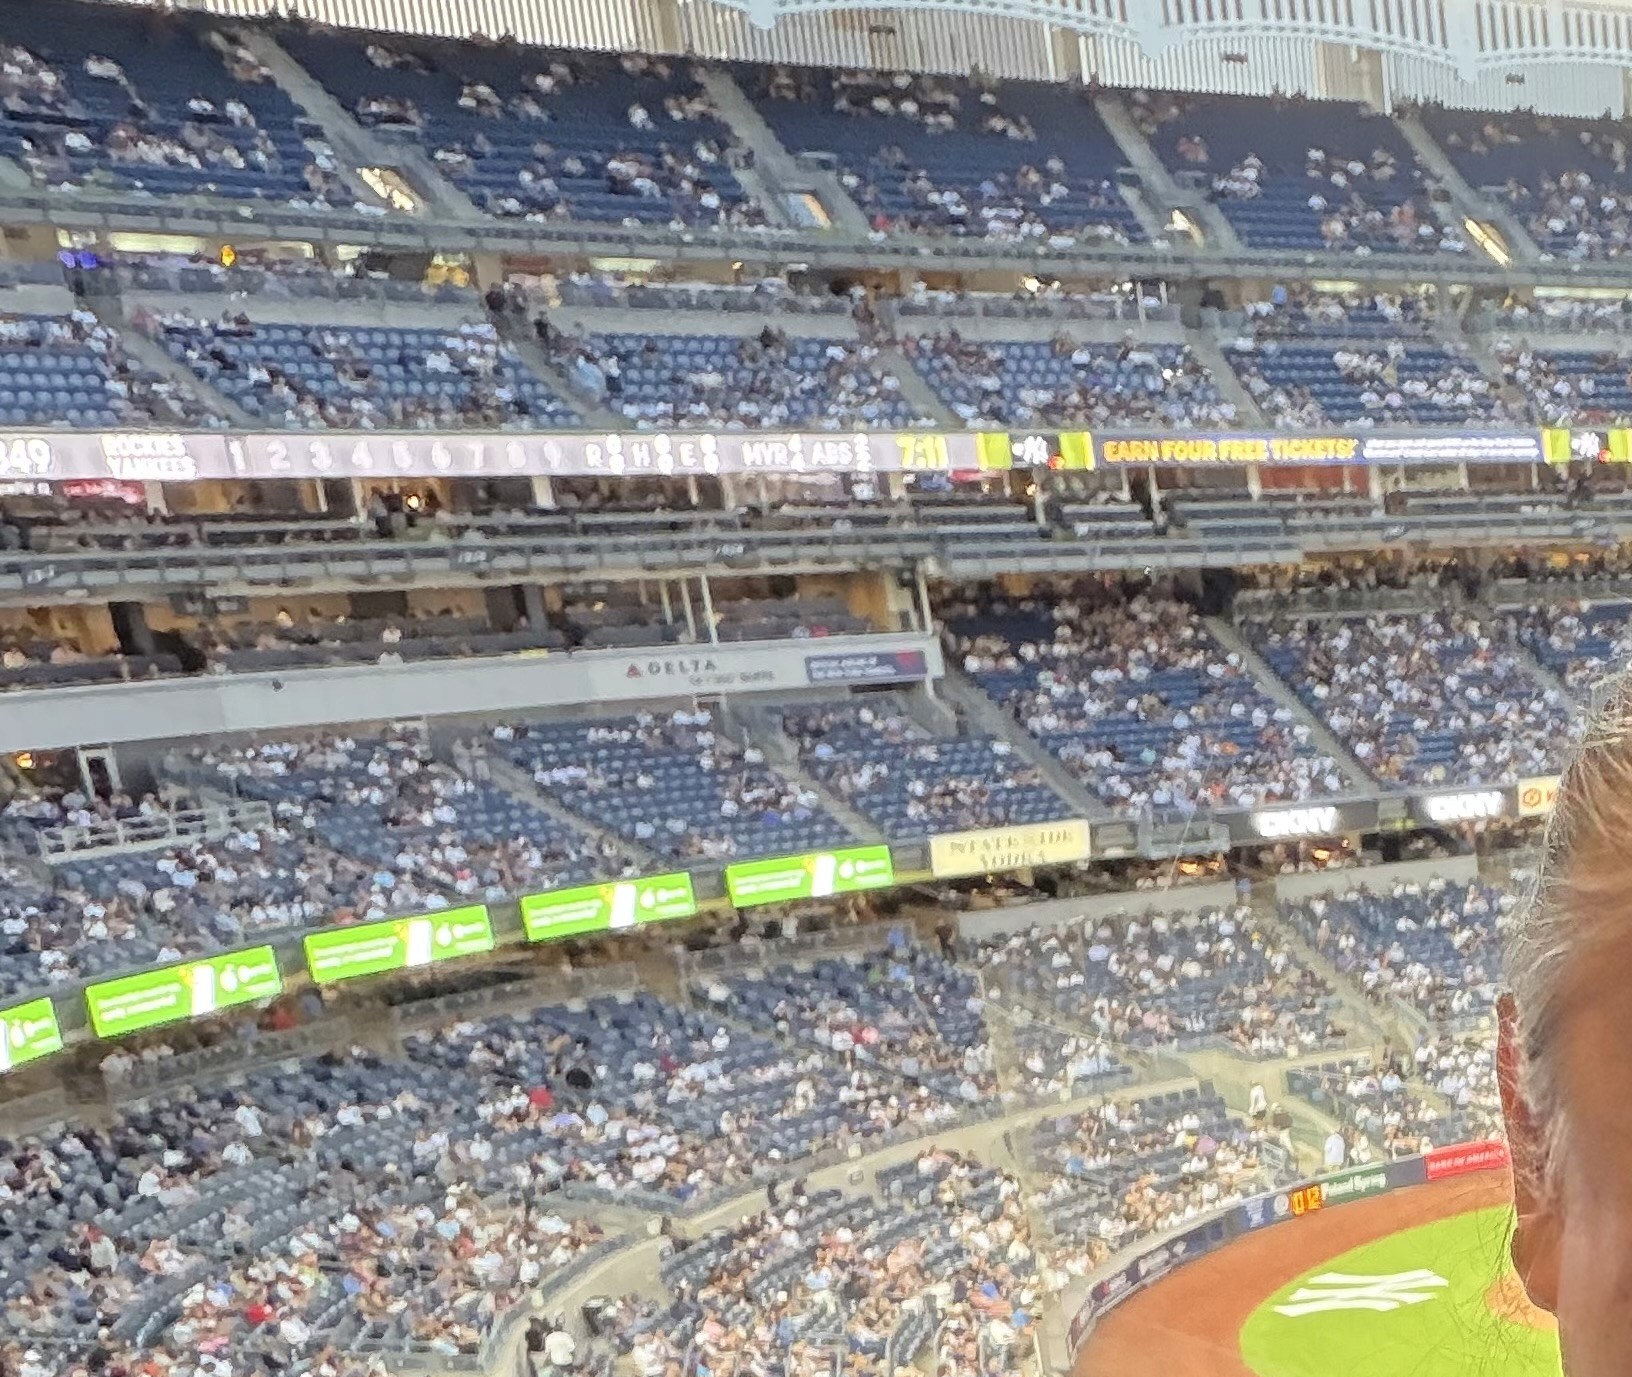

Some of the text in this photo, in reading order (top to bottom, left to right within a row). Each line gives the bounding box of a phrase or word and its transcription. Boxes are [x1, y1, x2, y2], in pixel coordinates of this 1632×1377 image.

[266, 439, 291, 470] 2
[585, 444, 696, 467] R H E
[741, 440, 854, 467] MVR ABS
[896, 435, 949, 469] 7:11
[1102, 440, 1159, 462] EARN
[1161, 439, 1218, 461] FOUR
[1219, 438, 1269, 460] FREE
[647, 659, 717, 676] DELTA
[1258, 791, 1502, 837] DKNY DKNY
